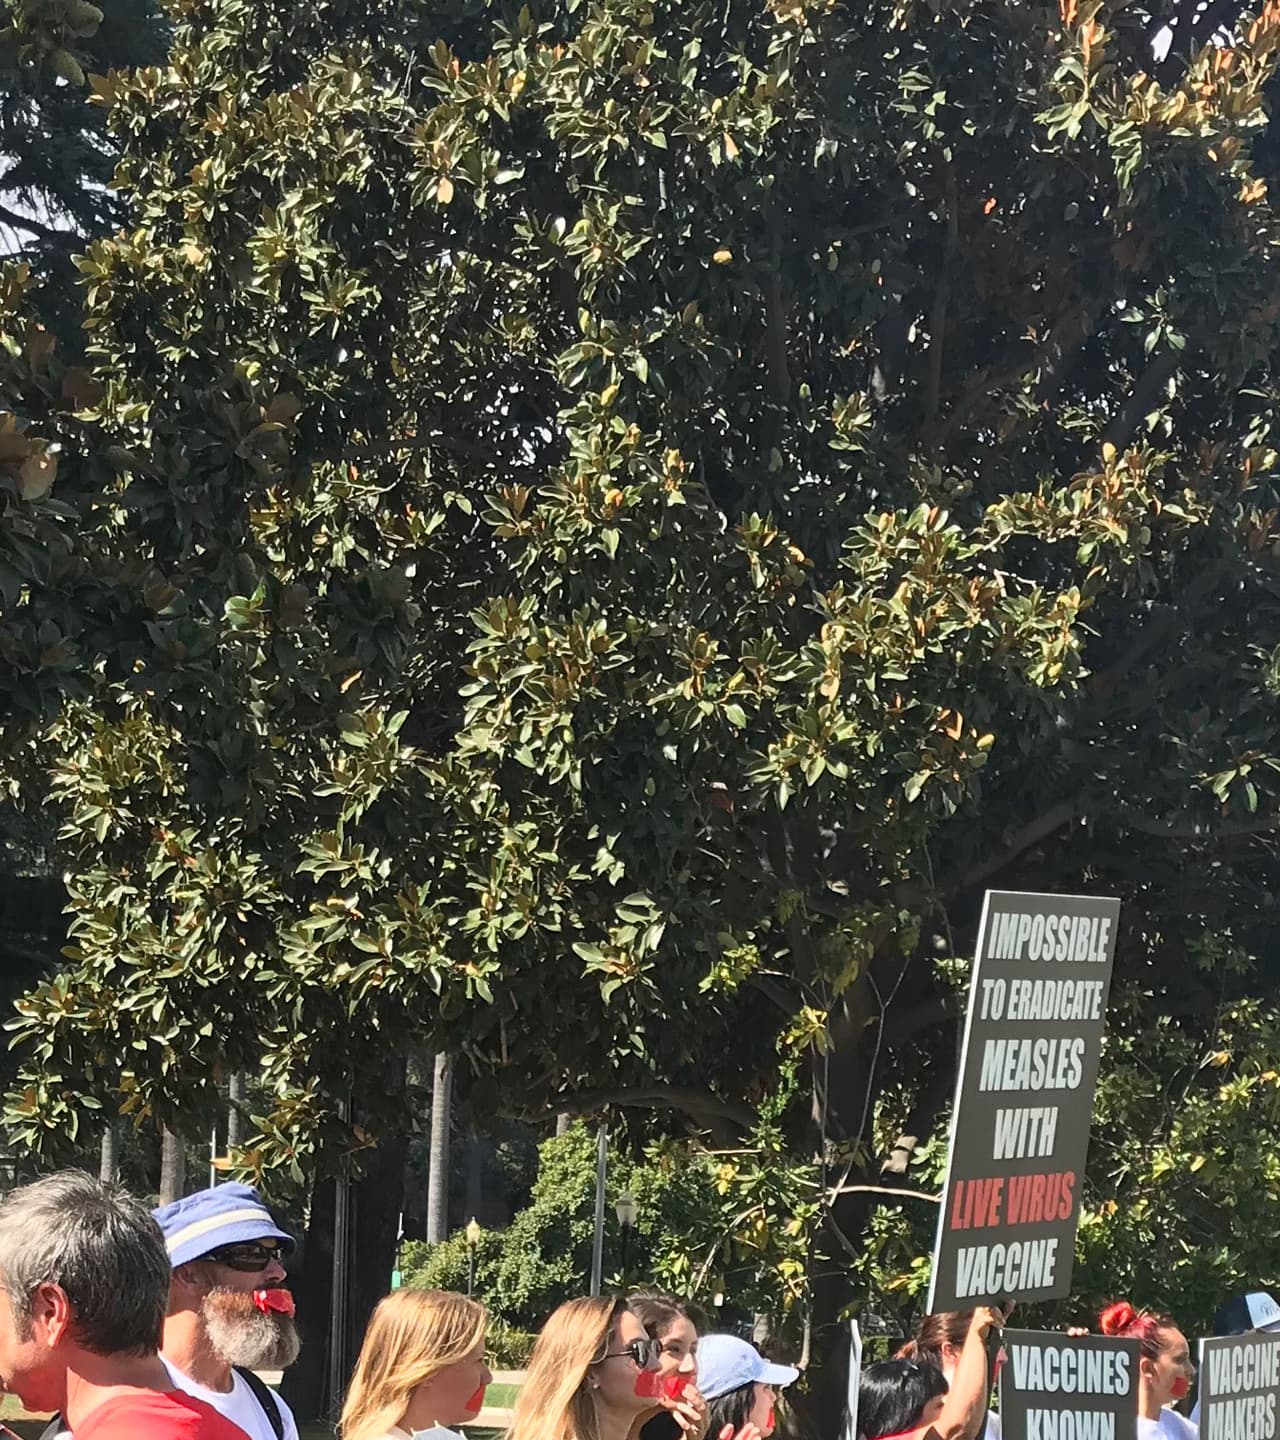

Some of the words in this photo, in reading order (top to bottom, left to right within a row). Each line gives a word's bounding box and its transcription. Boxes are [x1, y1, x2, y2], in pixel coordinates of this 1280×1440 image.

[987, 912, 1111, 963] IMPOSSIBLE
[980, 978, 1007, 1021] TO
[1007, 979, 1104, 1021] ERADICATE
[979, 1037, 1085, 1092] MEASLES
[992, 1106, 1058, 1160] WITH
[951, 1177, 1005, 1231] LIVE
[1007, 1171, 1076, 1226] VIRUS
[955, 1238, 1058, 1299] VACCINE
[1011, 1345, 1130, 1396] VACCINES
[1209, 1341, 1280, 1396] VACCINE
